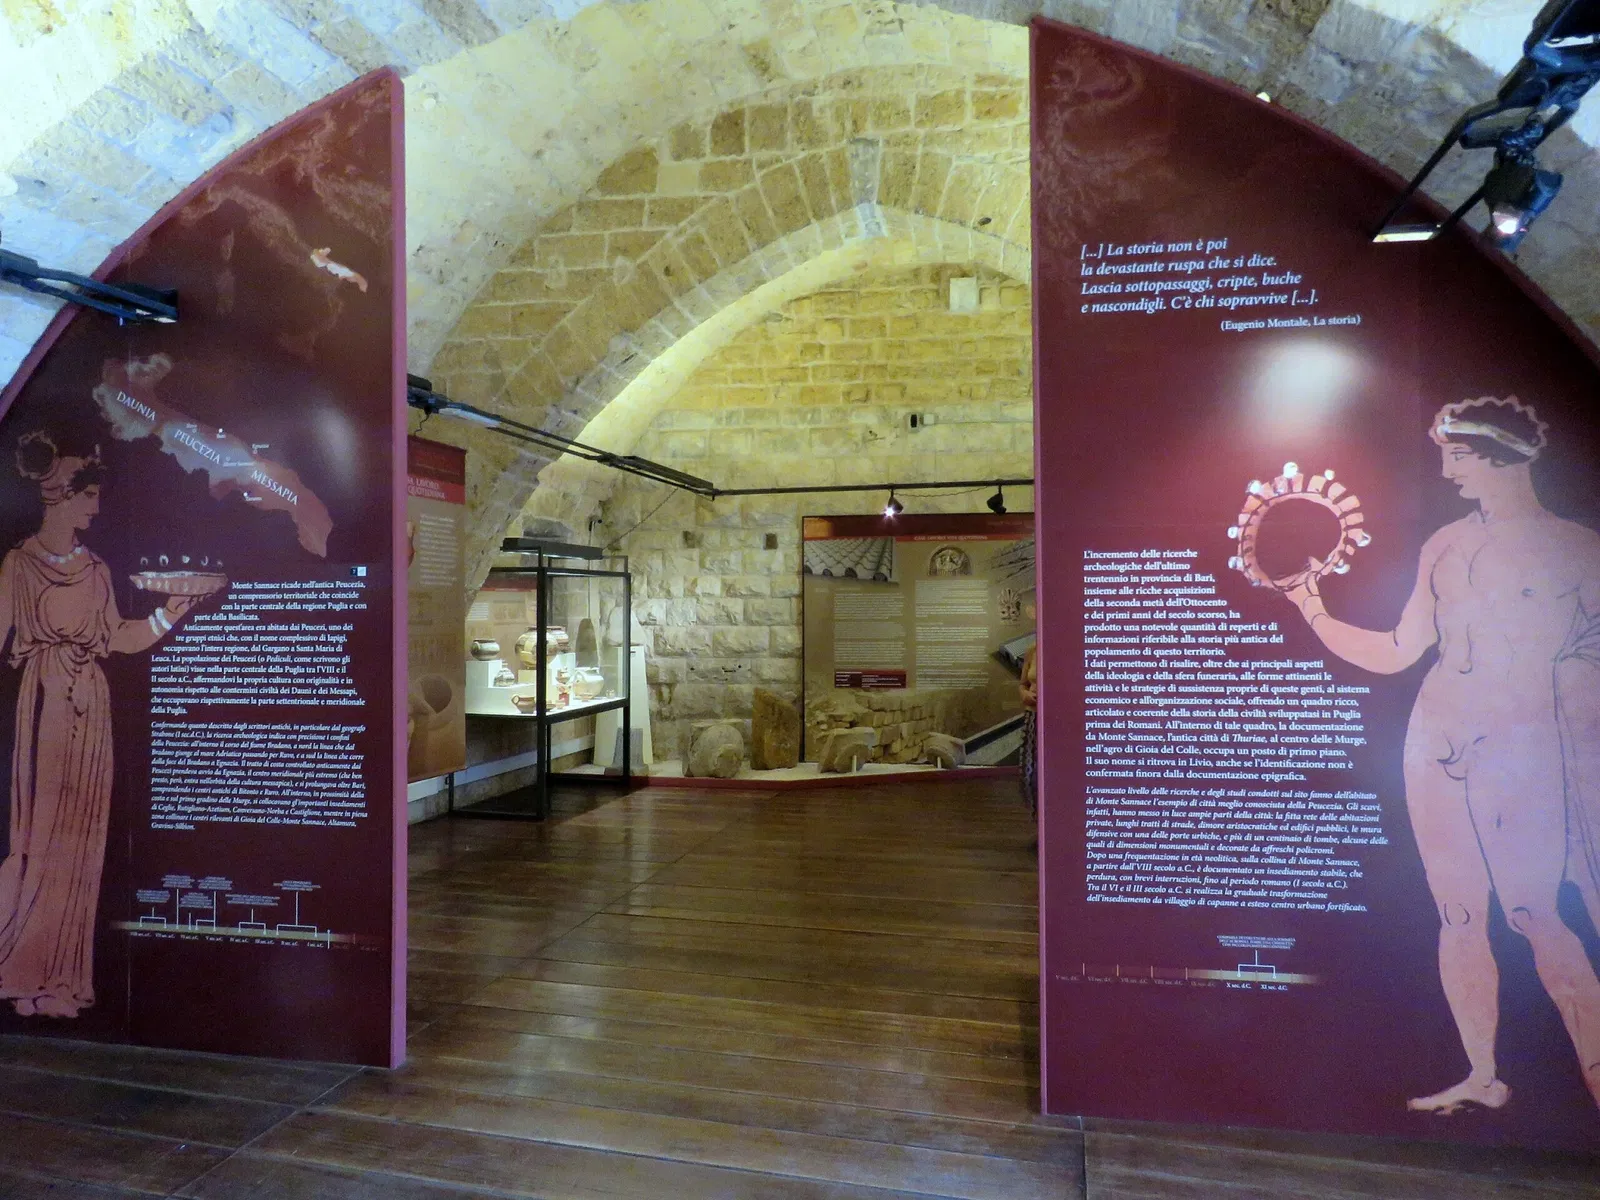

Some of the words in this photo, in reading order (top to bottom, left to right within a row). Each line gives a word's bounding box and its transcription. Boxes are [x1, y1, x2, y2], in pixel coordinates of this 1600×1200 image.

[1080, 244, 1103, 259] [...]
[1107, 243, 1124, 255] La
[1126, 241, 1164, 254] storia
[1167, 243, 1193, 252] non
[1195, 239, 1204, 250] è
[1206, 238, 1227, 253] poi
[1080, 264, 1094, 275] la
[1096, 261, 1165, 274] devastante
[1167, 262, 1205, 274] ruspa
[1207, 258, 1230, 269] che
[1233, 257, 1244, 268] si
[1246, 255, 1277, 267] dice.
[1081, 282, 1122, 294] Lascia
[1125, 277, 1214, 295] sottopassaggi,
[1216, 275, 1258, 291] cripte,
[1261, 273, 1301, 286] buche
[1081, 305, 1088, 313] e
[1091, 299, 1167, 316] nascondigli.
[1170, 298, 1192, 309] C'è
[1194, 297, 1215, 308] chi
[1217, 294, 1288, 310] sopravvive
[1291, 292, 1319, 307] [...].
[1220, 319, 1265, 332] (Eugenio
[1267, 317, 1310, 330] Montale,
[1313, 316, 1326, 326] La
[1328, 314, 1361, 328] storia)
[117, 391, 157, 421] DAUNIA
[174, 429, 221, 465] PEUCEZIA
[251, 470, 298, 506] MESSAPIA
[1084, 550, 1139, 558] L'incremento
[1140, 550, 1161, 558] delle
[1163, 549, 1198, 558] ricerche
[1083, 562, 1142, 573] archeologiche
[1143, 561, 1190, 570] dell'ultimo
[1084, 574, 1128, 583] trentennio
[1130, 574, 1139, 582] in
[1141, 574, 1182, 585] provincia
[1183, 574, 1192, 582] di
[1194, 574, 1215, 584] Bari,
[1084, 586, 1117, 595] insieme
[1118, 586, 1134, 595] alle
[1135, 586, 1162, 595] ricche
[1163, 586, 1215, 597] acquisizioni
[1084, 599, 1104, 607] della
[1106, 599, 1141, 607] seconda
[1142, 598, 1164, 607] metà
[1166, 598, 1227, 607] dell'Ottocento
[1091, 610, 1104, 619] dei
[1106, 610, 1130, 621] primi
[1131, 610, 1151, 619] anni
[1153, 610, 1166, 619] del
[1168, 610, 1195, 619] secolo
[1197, 613, 1227, 621] scorso,
[1229, 610, 1240, 619] ha
[1084, 623, 1122, 633] prodotto
[1142, 623, 1178, 631] notevole
[1180, 623, 1216, 633] quantità
[1218, 623, 1227, 631] di
[1229, 623, 1259, 633] reperti
[1268, 623, 1277, 631] di
[1084, 635, 1139, 643] informazioni
[1141, 635, 1179, 643] riferibile
[1180, 635, 1196, 643] alla
[1197, 635, 1222, 643] storia
[1224, 635, 1239, 646] più
[1240, 635, 1268, 643] antica
[1269, 635, 1283, 643] del
[1084, 647, 1141, 658] popolamento
[1142, 647, 1151, 656] di
[1153, 647, 1182, 658] questo
[1184, 647, 1225, 656] territorio.
[1098, 733, 1126, 741] Monte
[1128, 733, 1166, 744] Sannace,
[1167, 734, 1197, 742] l'antica
[1199, 734, 1218, 742] città
[1232, 734, 1267, 745] Thuriae,
[1280, 735, 1309, 743] centro
[1311, 735, 1332, 744] delle
[1335, 735, 1366, 746] Murge,
[1147, 757, 1176, 766] ritrova
[1189, 758, 1213, 769] Livio,
[1215, 759, 1242, 767] anche
[1254, 759, 1325, 769] l'identificazione
